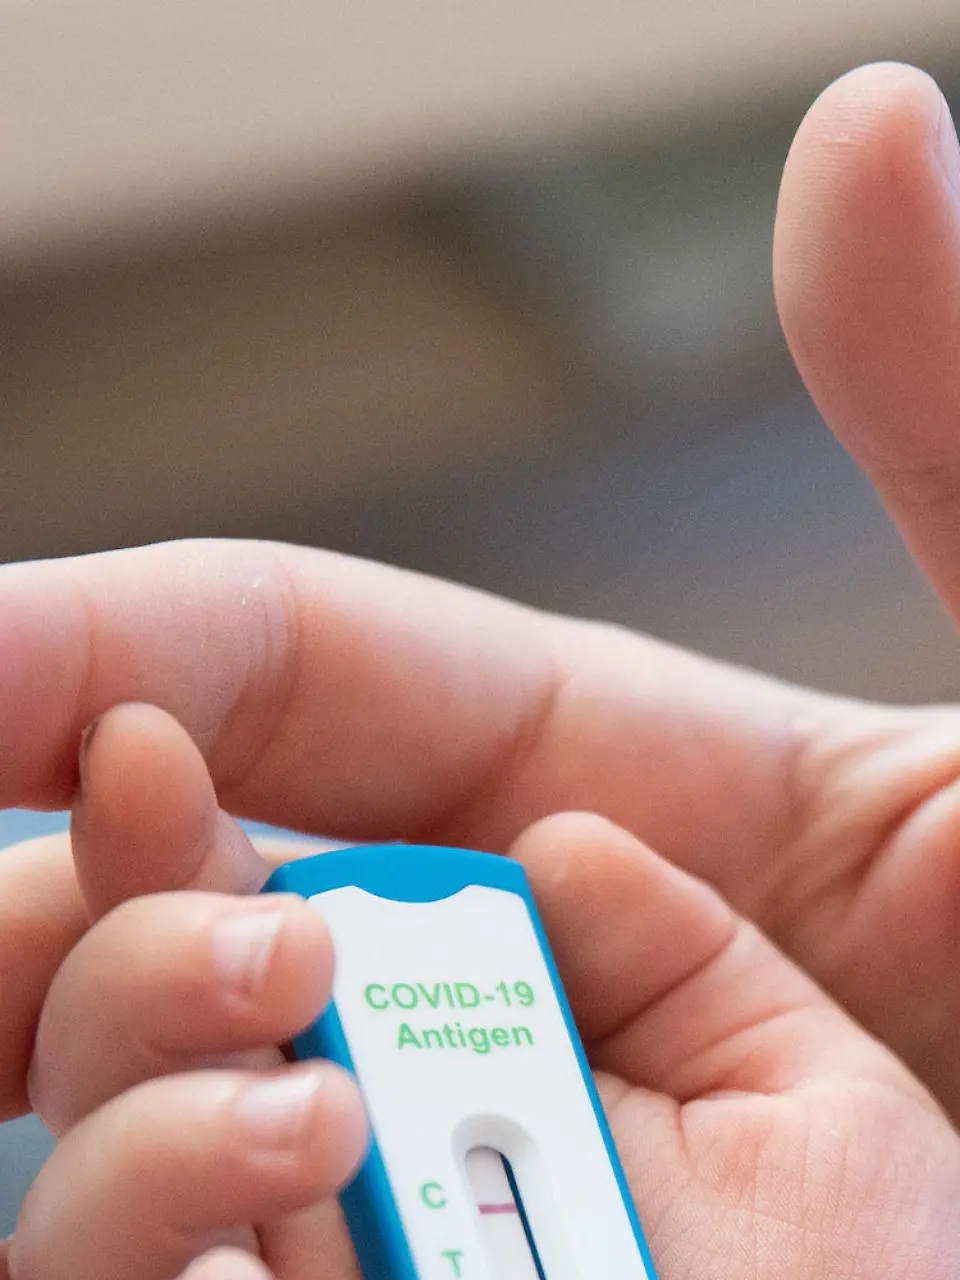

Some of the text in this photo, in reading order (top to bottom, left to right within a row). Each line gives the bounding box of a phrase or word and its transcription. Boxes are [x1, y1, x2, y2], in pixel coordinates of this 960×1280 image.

[364, 980, 536, 1010] COVID-19
[397, 1022, 535, 1054] Antigen
[419, 1181, 447, 1209] C
[440, 1249, 463, 1278] T
